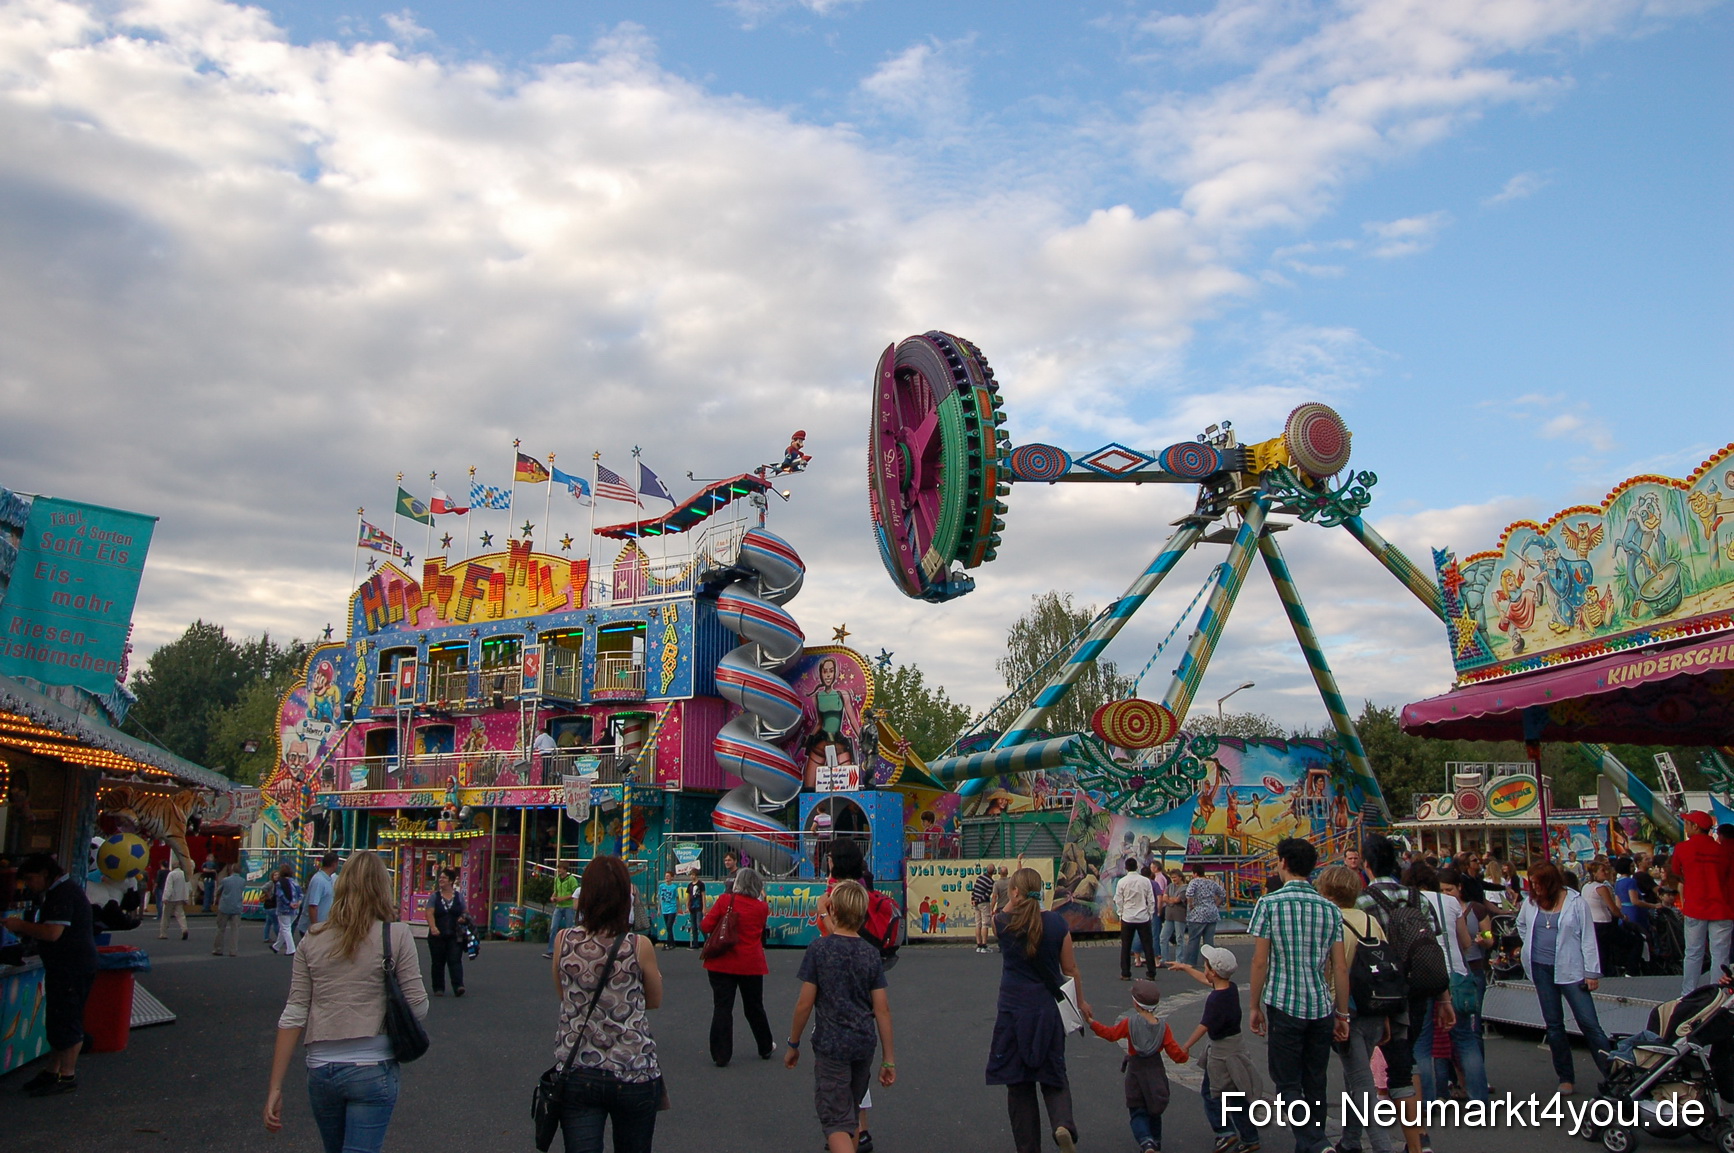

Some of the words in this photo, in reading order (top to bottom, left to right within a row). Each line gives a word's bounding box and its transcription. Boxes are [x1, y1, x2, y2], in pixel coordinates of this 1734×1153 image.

[883, 449, 896, 479] Dreh
[51, 510, 87, 526] Tägl.
[76, 525, 86, 537] 4
[90, 527, 133, 546] Sorten
[359, 563, 455, 634] HAPPY
[455, 539, 590, 622] FAMILY
[51, 590, 114, 614] mohr
[660, 603, 679, 695] HAPPY
[352, 638, 368, 716] HAPPY
[340, 793, 371, 806] SUPER
[409, 792, 435, 805] COOL
[909, 865, 935, 876] Viel
[941, 881, 963, 892] auf
